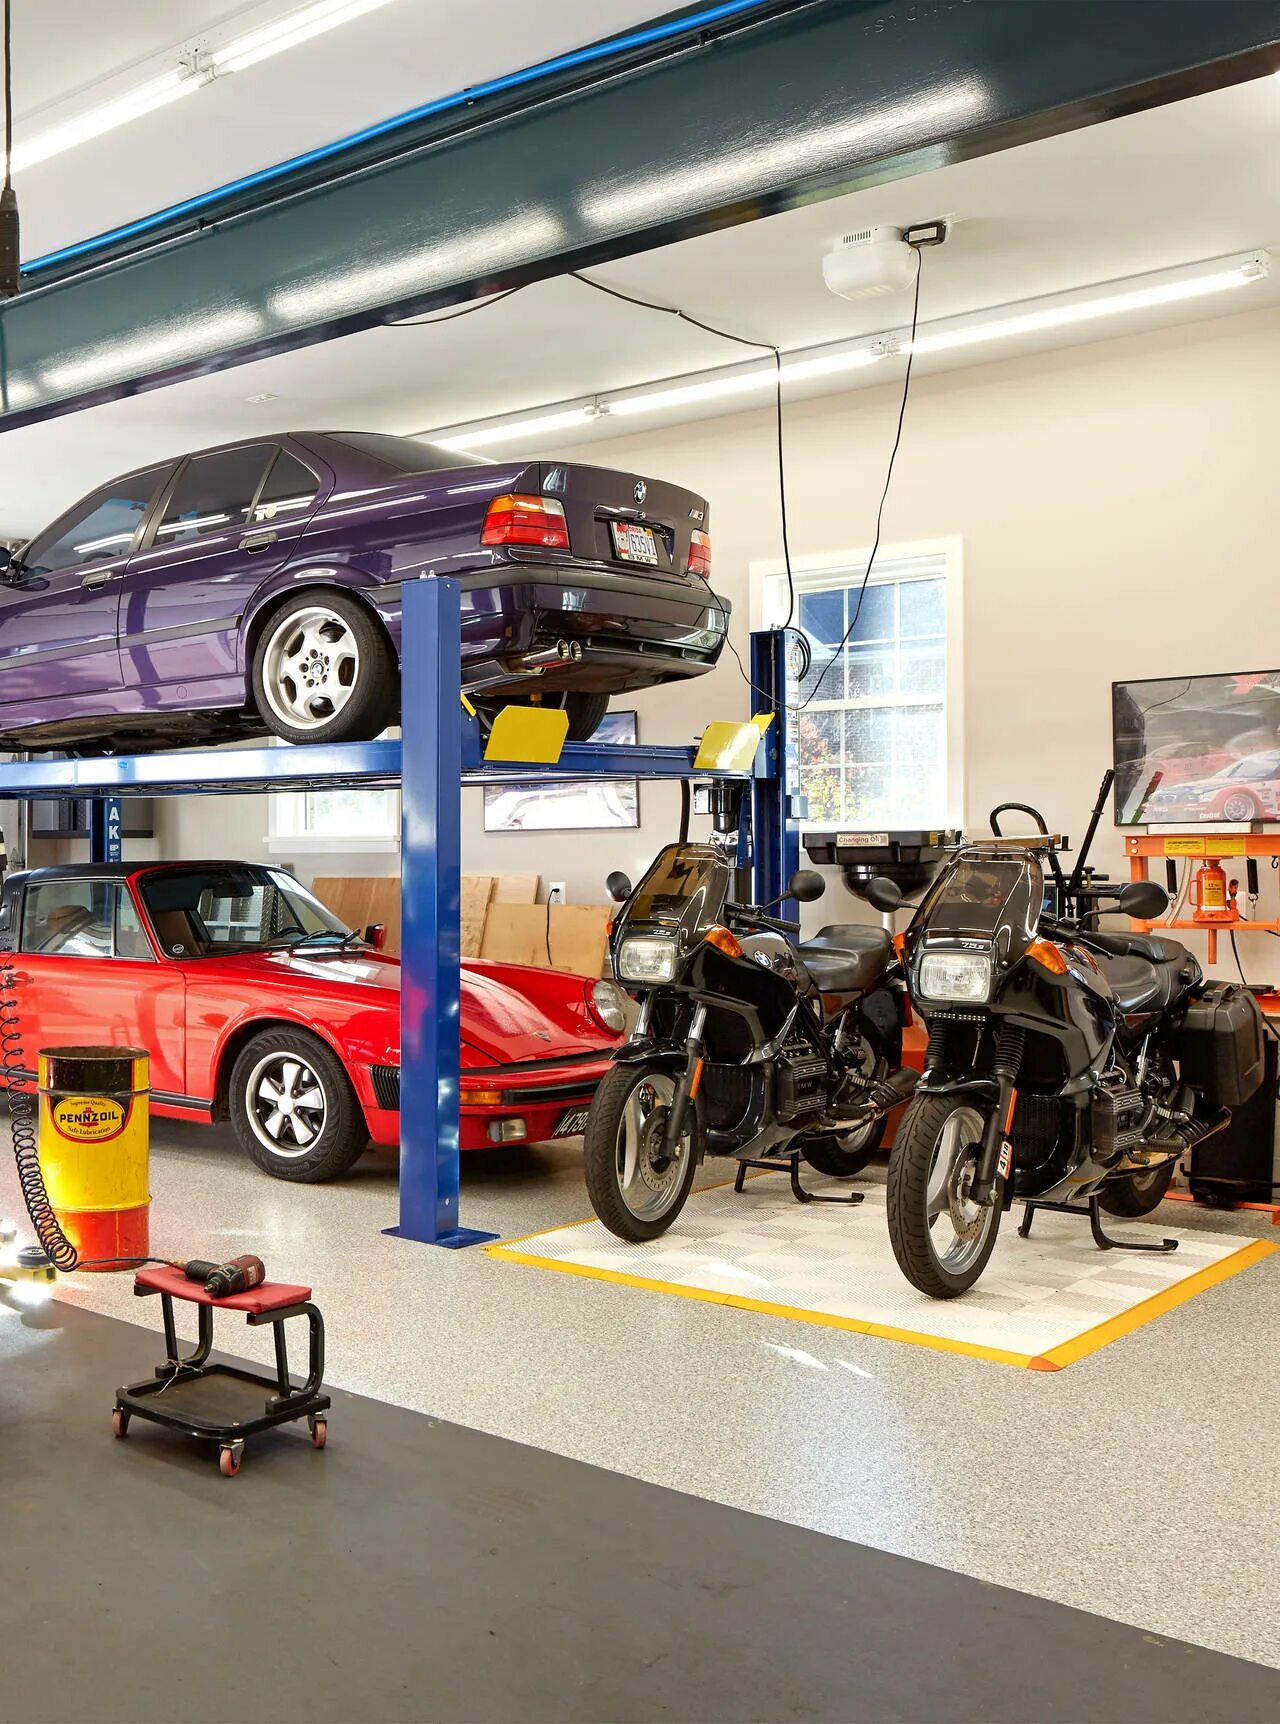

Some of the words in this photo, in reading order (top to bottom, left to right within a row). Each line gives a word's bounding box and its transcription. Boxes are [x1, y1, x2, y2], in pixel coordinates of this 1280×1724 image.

[838, 836, 869, 844] Changing
[90, 1098, 106, 1107] Quality
[59, 1111, 119, 1123] PENNZOIL
[67, 1126, 79, 1134] Safe
[79, 1126, 111, 1135] Lubrication
